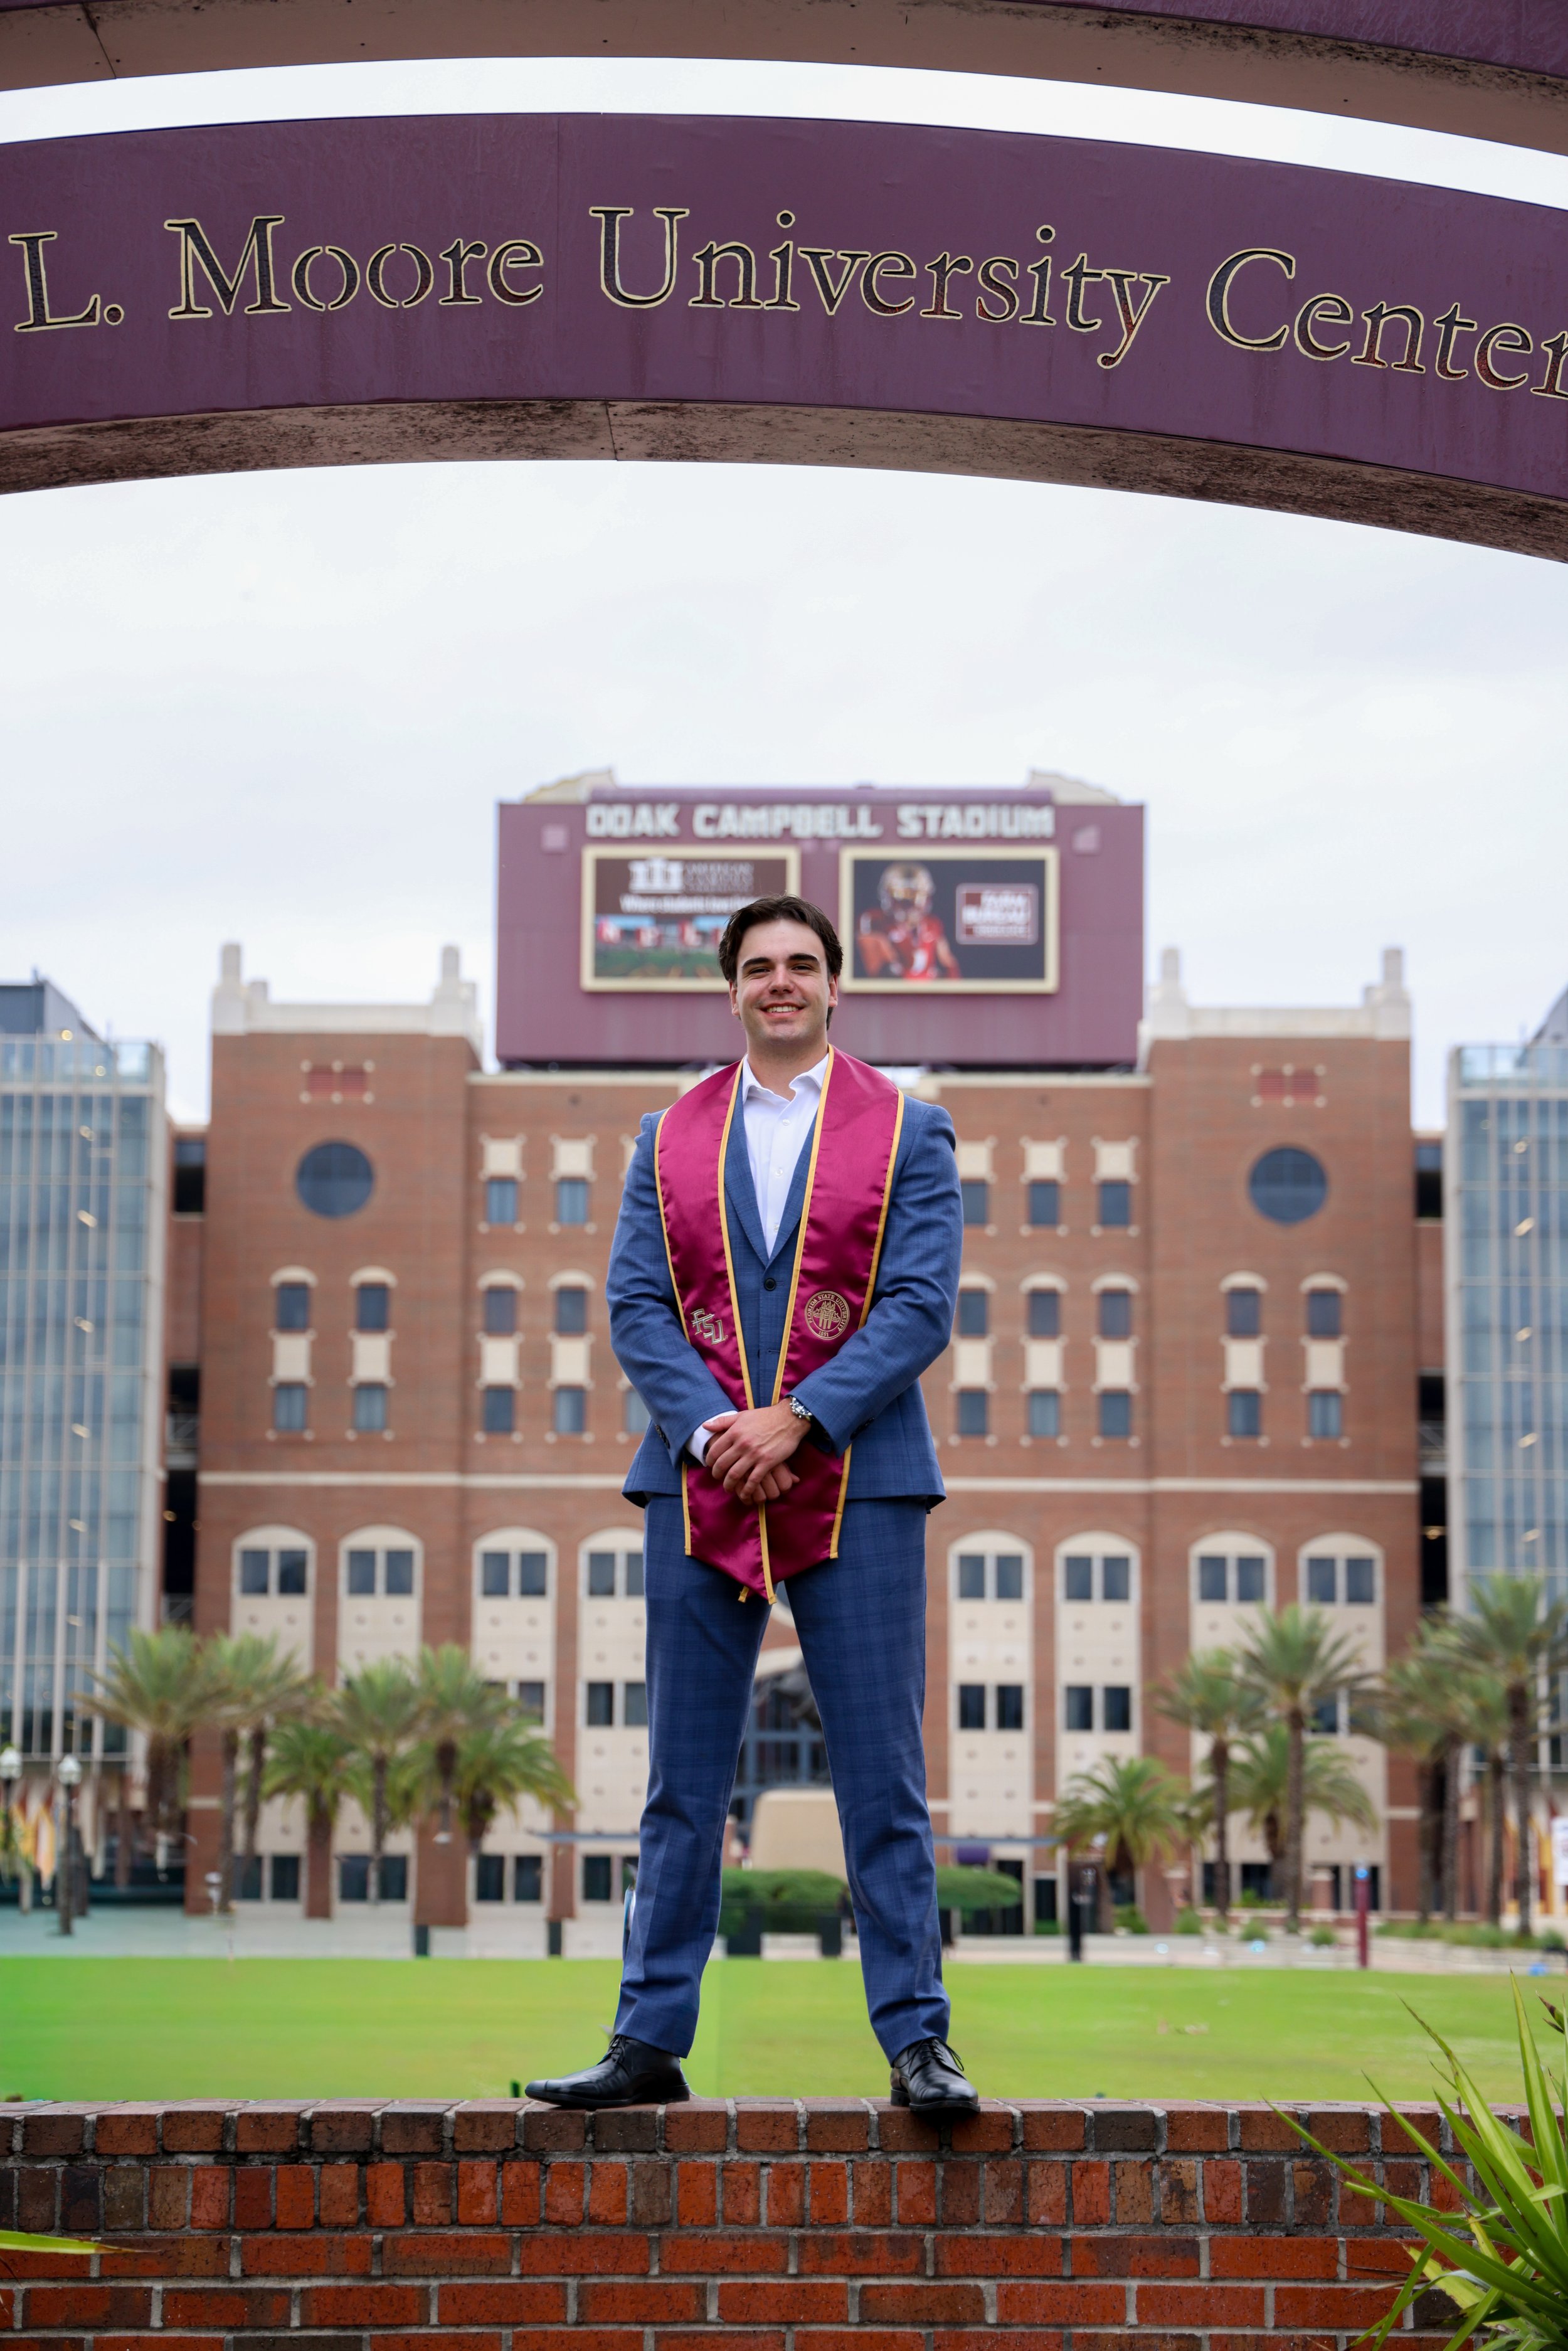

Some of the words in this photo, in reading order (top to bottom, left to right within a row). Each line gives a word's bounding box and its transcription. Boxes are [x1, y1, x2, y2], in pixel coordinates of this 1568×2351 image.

[8, 231, 125, 332] L.
[164, 215, 544, 319] Moore
[588, 206, 1171, 369] University
[1205, 247, 1568, 401] Center
[586, 804, 681, 838] DOAK
[692, 804, 884, 839] CAMPBELL
[897, 805, 1055, 838] STADIUM
[690, 1308, 726, 1345] FSU
[807, 1298, 818, 1324] FLORIDA
[835, 1297, 847, 1332] UNIVERSITY
